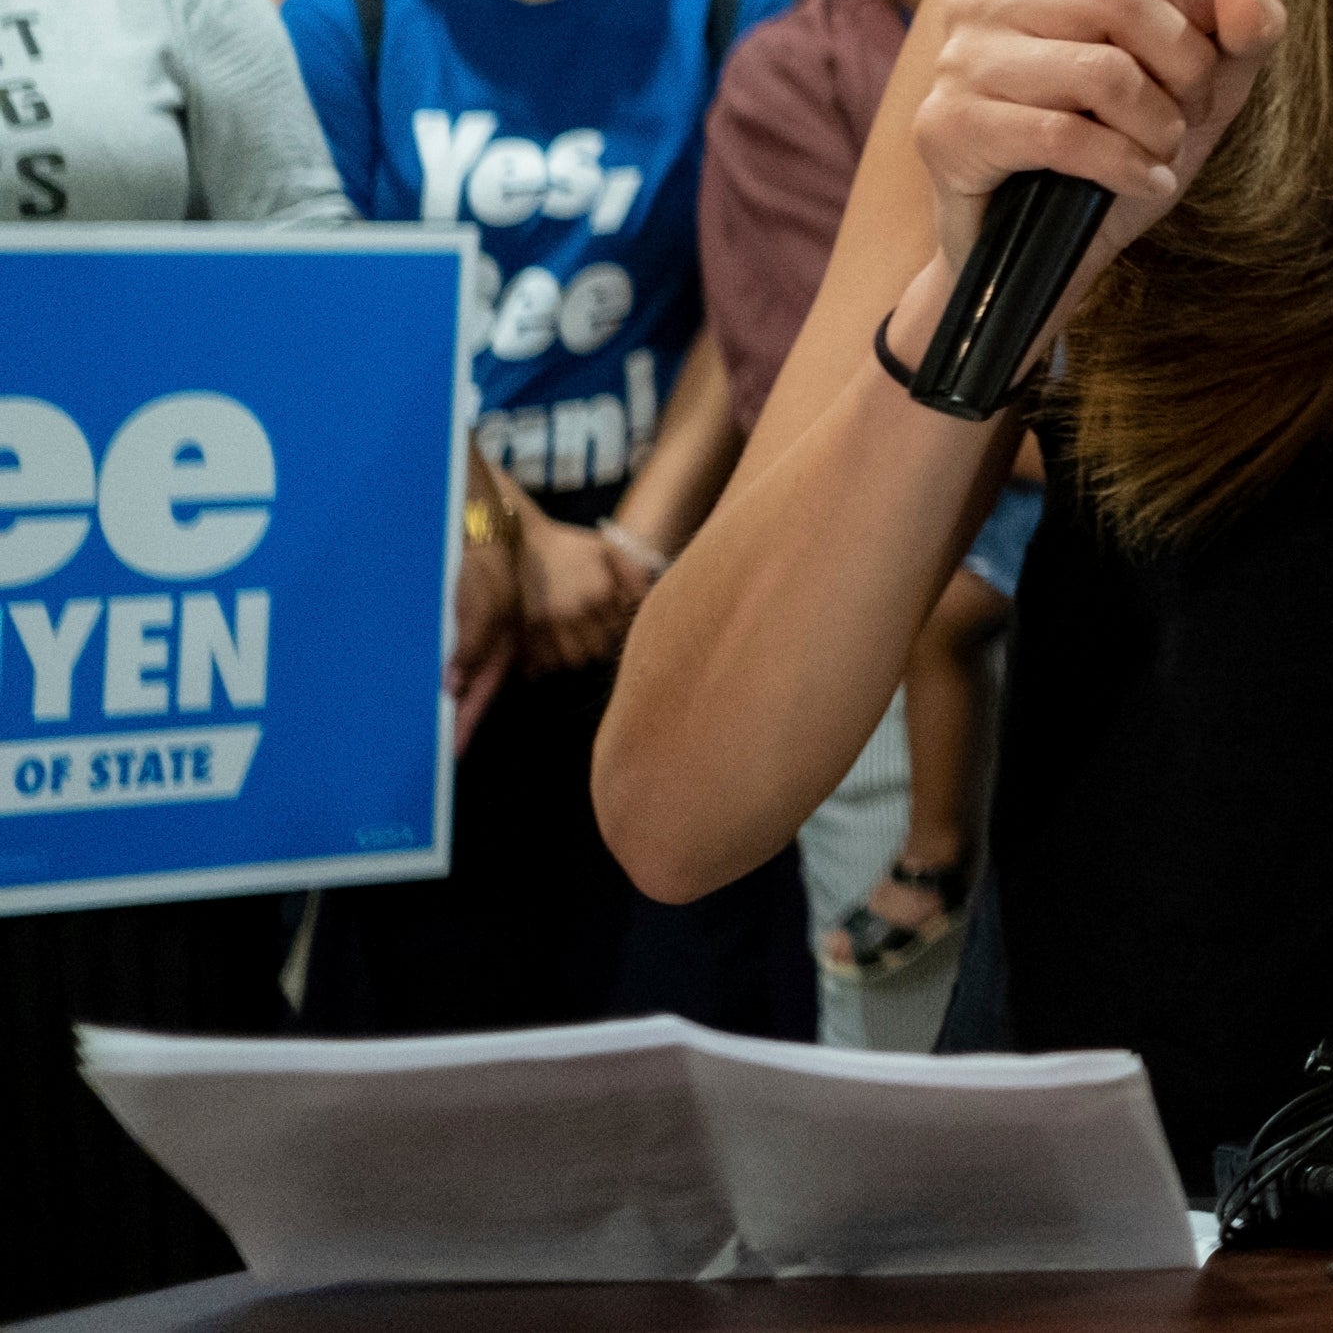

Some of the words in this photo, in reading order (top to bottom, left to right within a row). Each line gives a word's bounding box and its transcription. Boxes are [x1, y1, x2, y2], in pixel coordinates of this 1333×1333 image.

[412, 108, 643, 235] Yes,
[471, 349, 657, 494] an!
[0, 390, 277, 590] ee
[14, 755, 71, 800] OF
[89, 744, 212, 794] STATE
